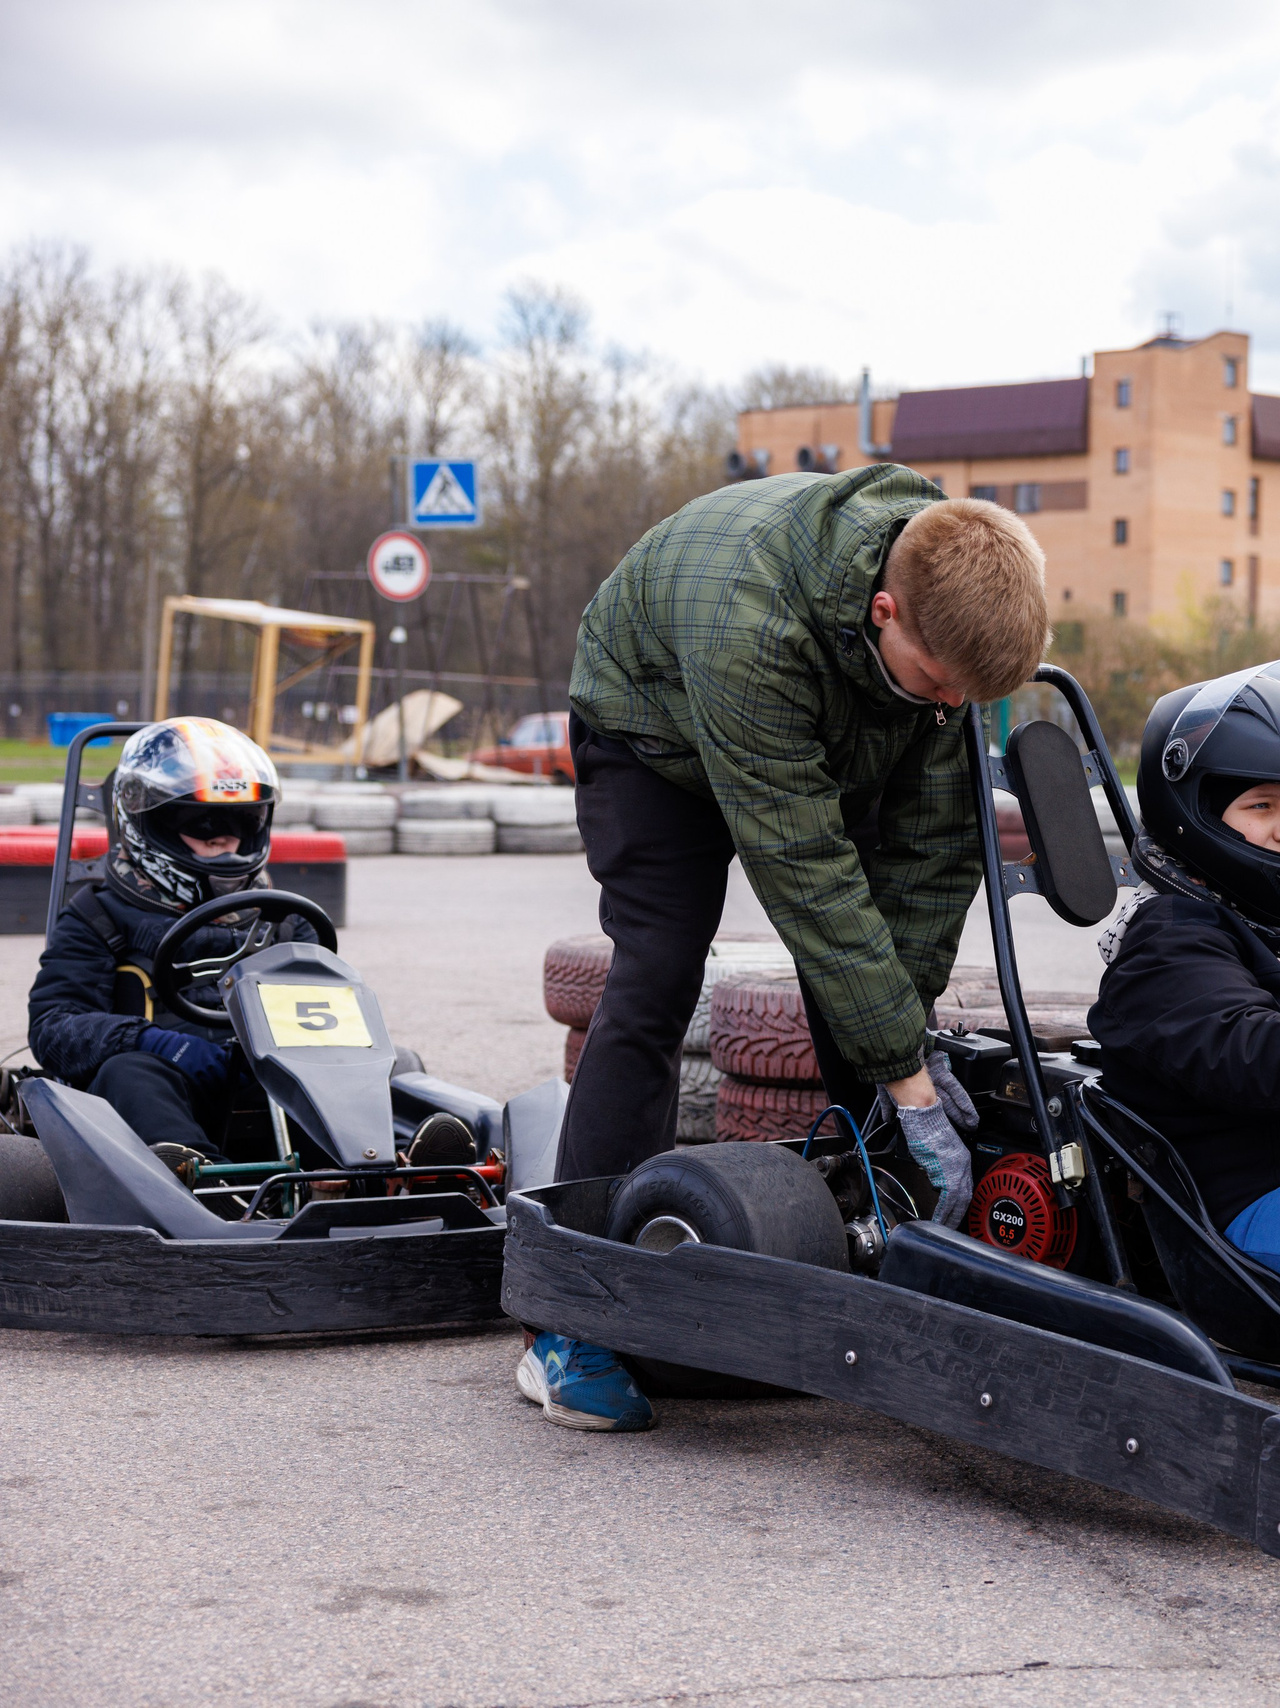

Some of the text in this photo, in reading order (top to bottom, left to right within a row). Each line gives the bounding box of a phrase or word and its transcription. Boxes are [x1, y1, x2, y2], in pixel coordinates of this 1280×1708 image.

[295, 1001, 339, 1031] 5
[992, 1210, 1024, 1227] GX200
[998, 1224, 1015, 1240] 6.5
[876, 1335, 1002, 1392] KART
